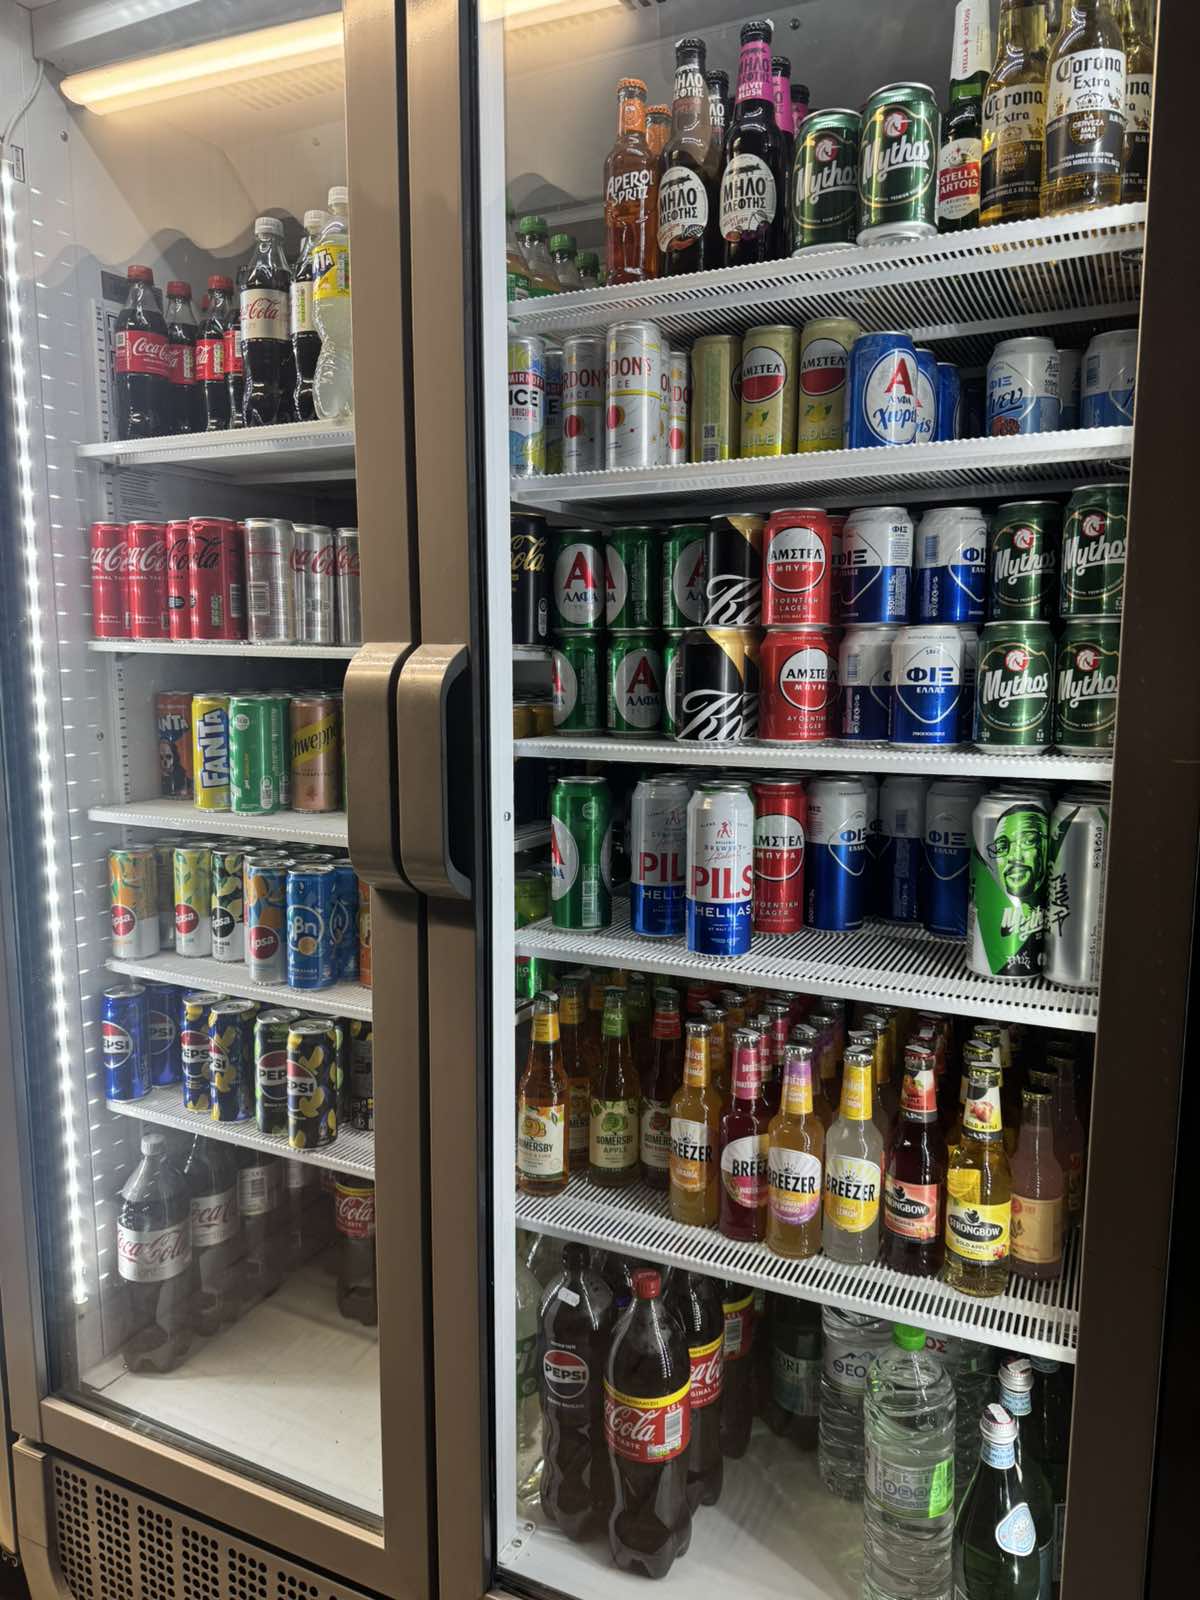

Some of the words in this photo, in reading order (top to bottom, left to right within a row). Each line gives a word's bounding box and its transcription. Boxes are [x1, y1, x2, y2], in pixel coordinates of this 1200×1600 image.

[1056, 55, 1121, 82] Corona
[1073, 76, 1110, 89] Extra
[863, 136, 930, 184] Mythos
[940, 168, 978, 184] STELLA
[724, 177, 766, 202] ΜΗΛΟ
[939, 180, 979, 194] ARTOIS
[509, 389, 538, 407] ICE
[771, 548, 822, 560] ΑΜΣΤΕΛ
[962, 548, 985, 563] ΦΙ
[906, 667, 953, 682] ΦΙΞ
[983, 669, 1048, 708] Mythos
[198, 711, 229, 787] FANTA
[639, 852, 684, 881] PIL
[691, 865, 752, 898] PILS
[642, 889, 686, 900] HELLA
[696, 904, 751, 917] HELLAS
[260, 1070, 287, 1080] PEP
[288, 1082, 314, 1094] PSI
[768, 1167, 815, 1194] BREEZER
[826, 1173, 876, 1202] BREEZER
[950, 1218, 1000, 1236] STRONGBOW
[545, 1366, 586, 1381] PEPSI
[833, 1360, 866, 1378] ΘΕΟ
